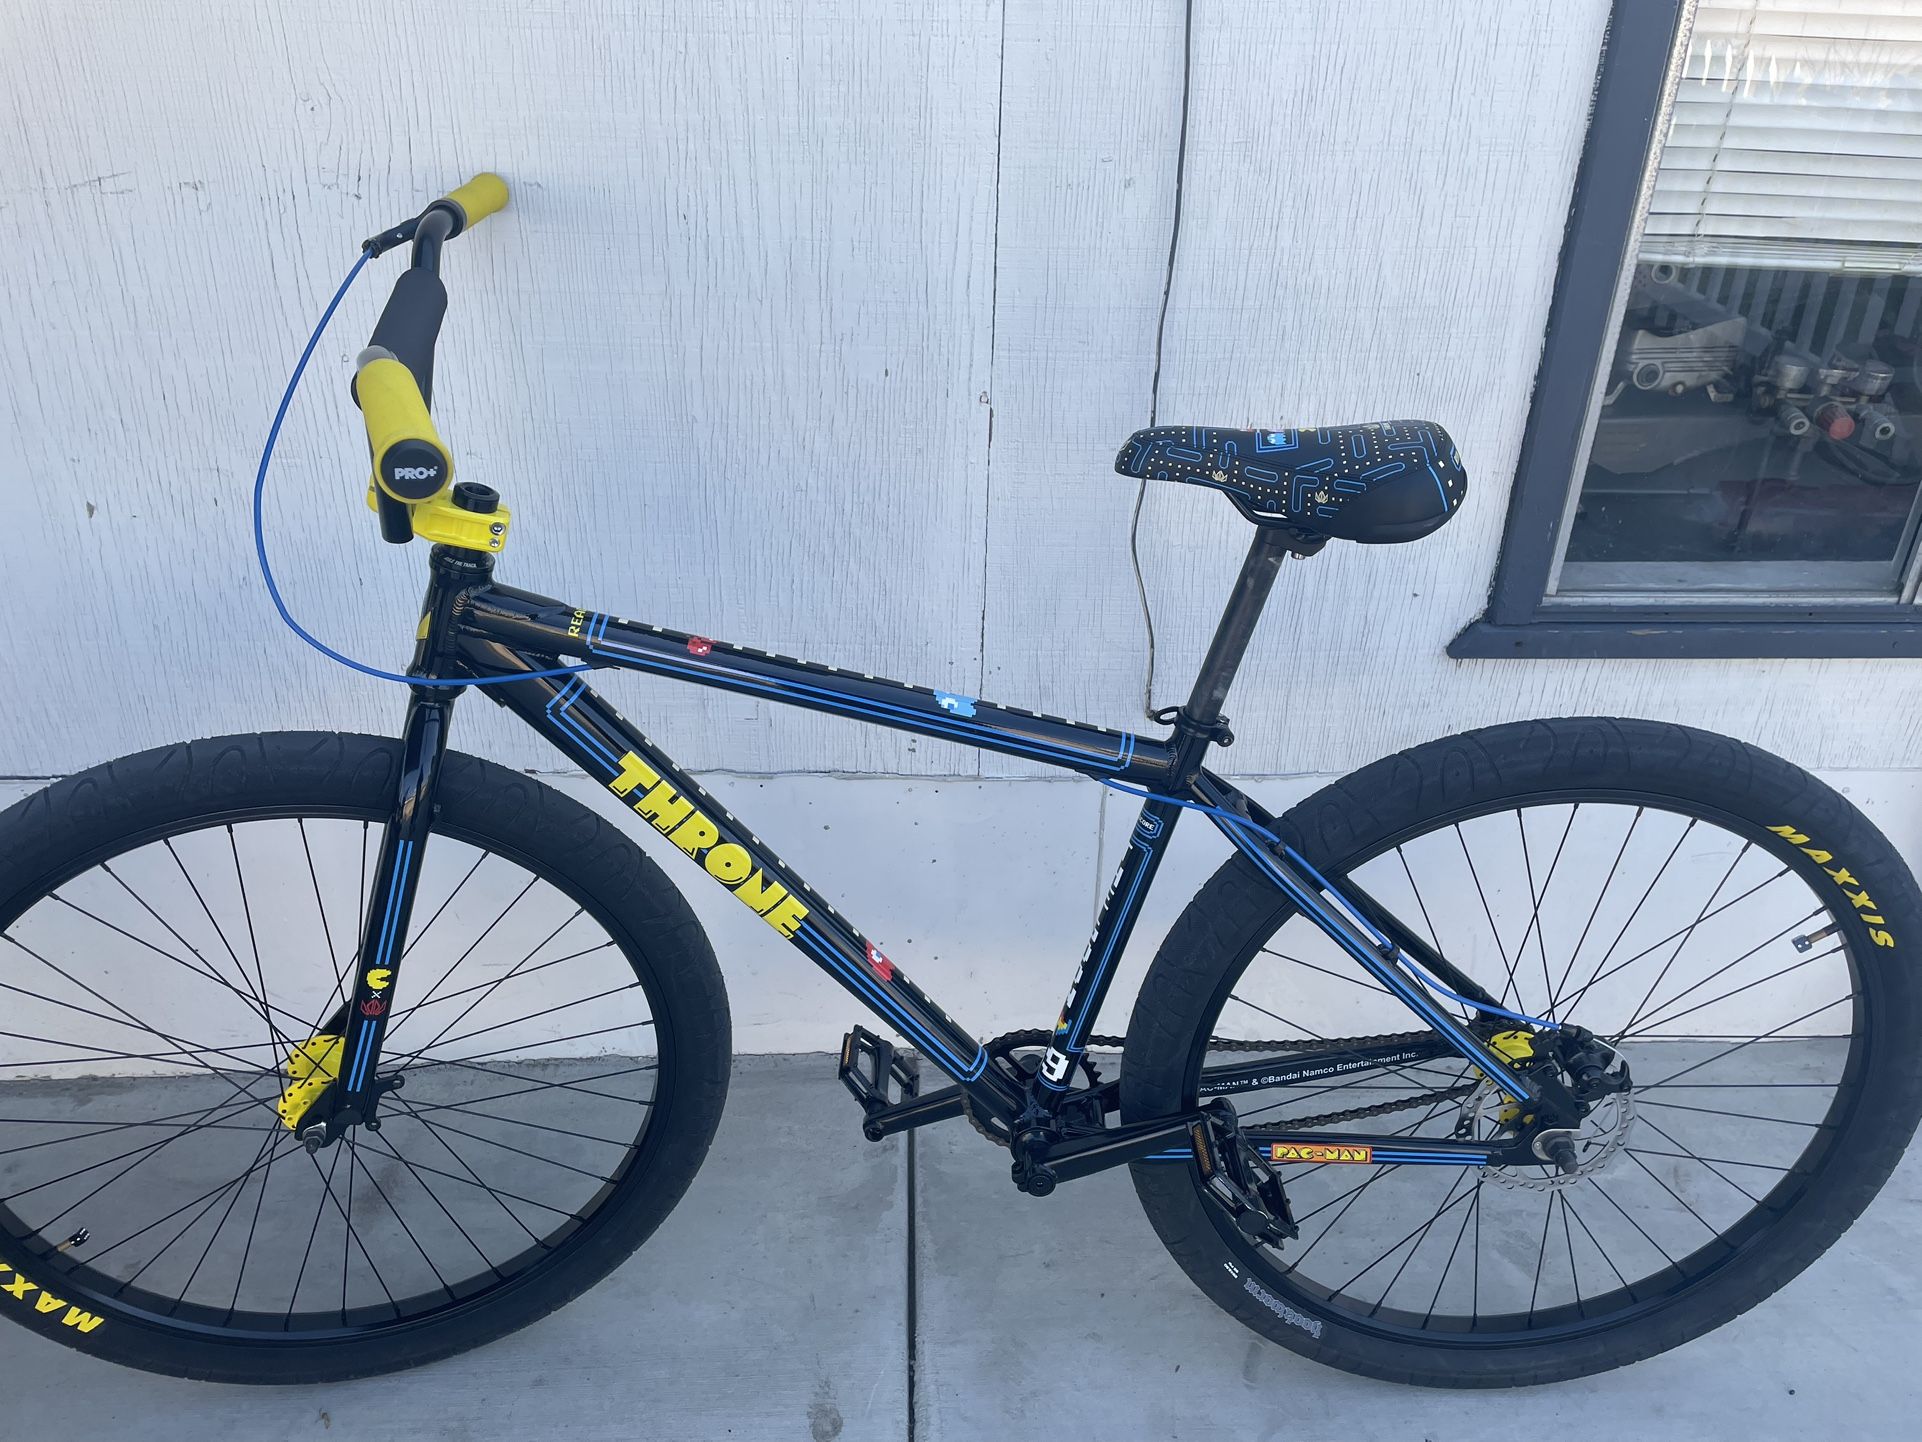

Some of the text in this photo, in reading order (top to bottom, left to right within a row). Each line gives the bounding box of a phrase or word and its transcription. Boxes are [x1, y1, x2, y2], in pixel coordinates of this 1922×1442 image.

[608, 750, 810, 940] THRONE
[1765, 825, 1895, 949] MAXXIS
[1251, 1078, 1259, 1086] &
[1303, 1066, 1334, 1078] Namco
[1402, 1051, 1419, 1061] Inc.
[1276, 1146, 1367, 1161] PAC-MAN
[0, 1263, 105, 1333] MAX
